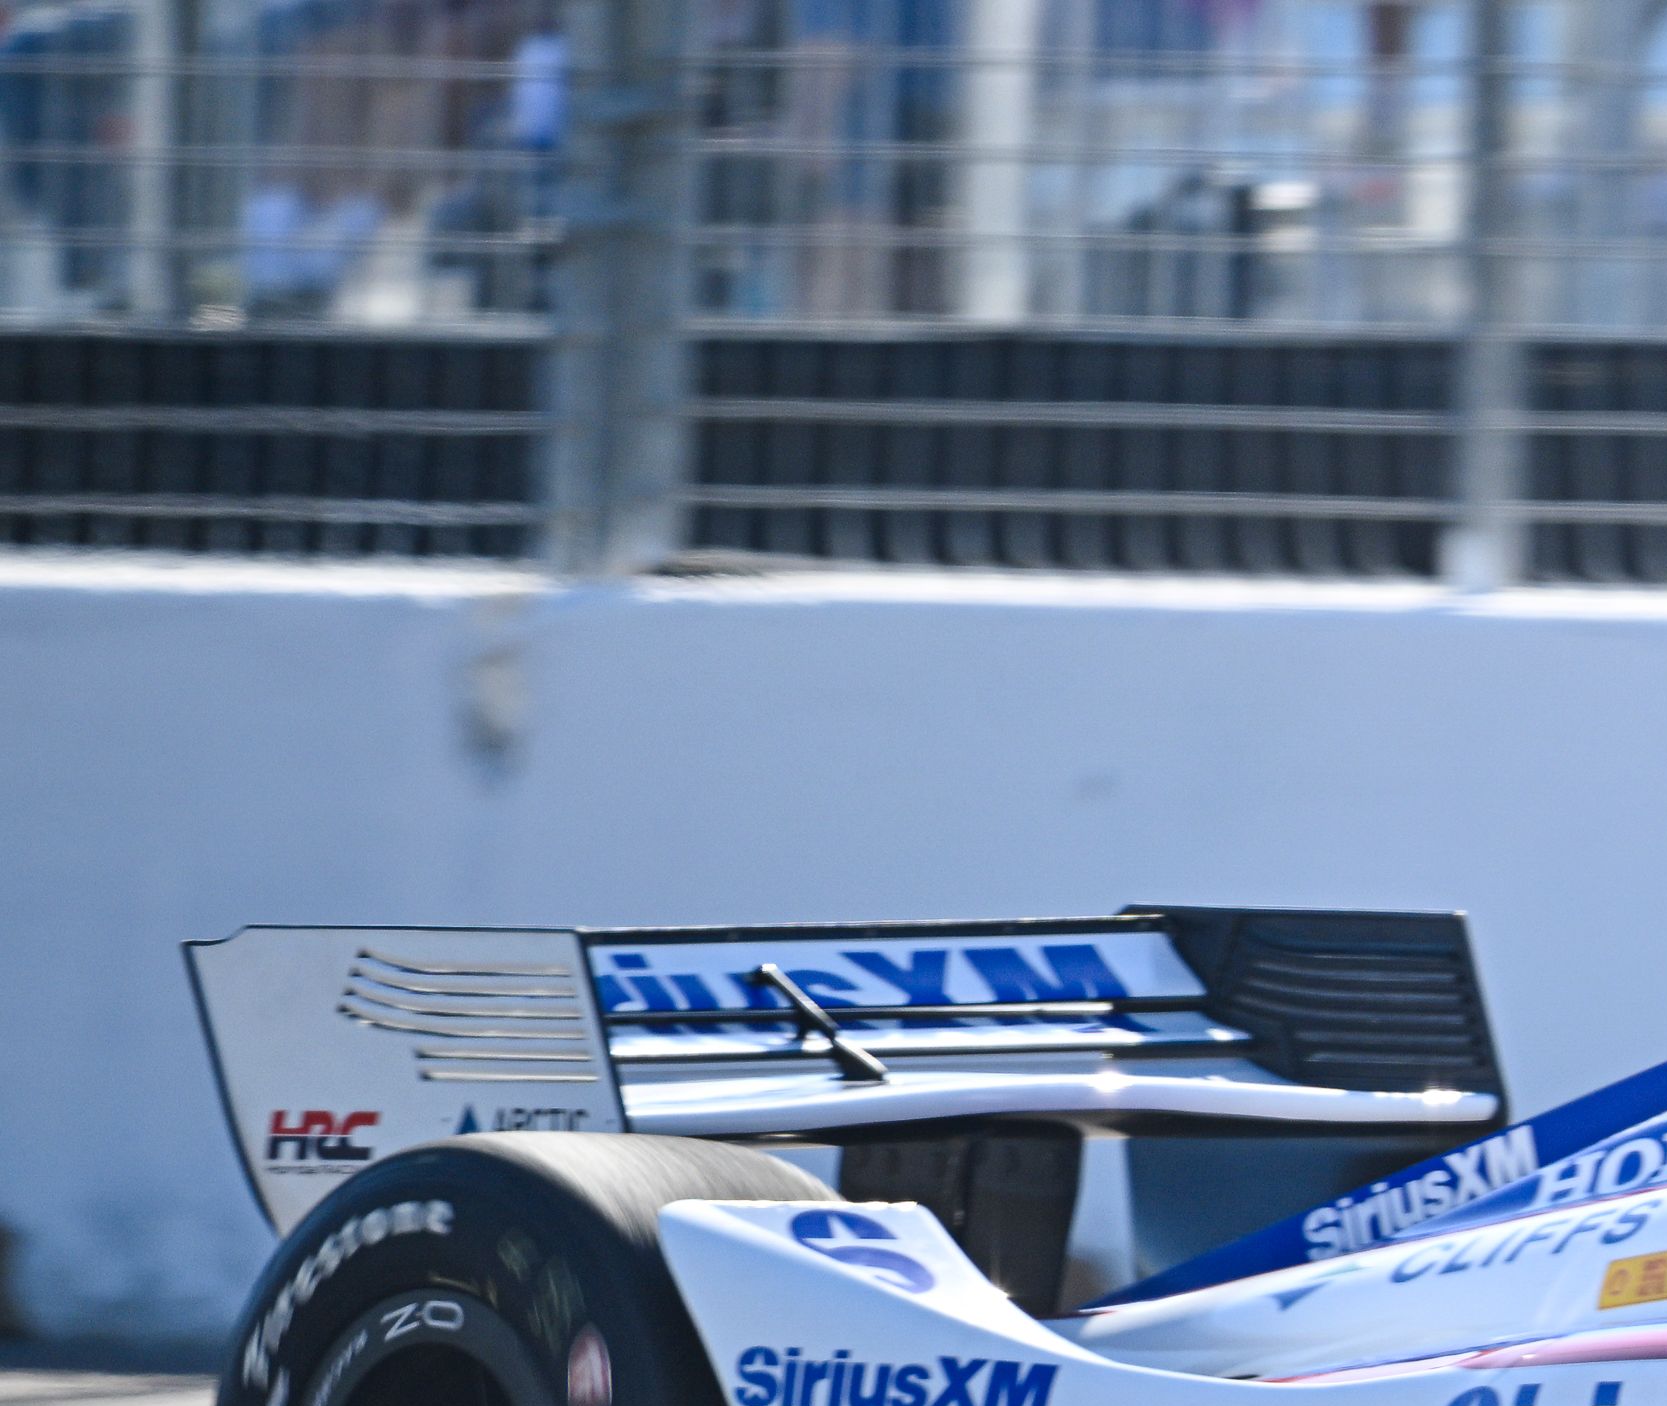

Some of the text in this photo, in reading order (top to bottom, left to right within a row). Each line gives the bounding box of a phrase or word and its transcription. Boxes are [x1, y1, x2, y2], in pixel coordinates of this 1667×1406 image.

[267, 1110, 381, 1160] HRC
[1303, 1125, 1539, 1260] SiriusXM
[1390, 1200, 1661, 1284] CLIFFS
